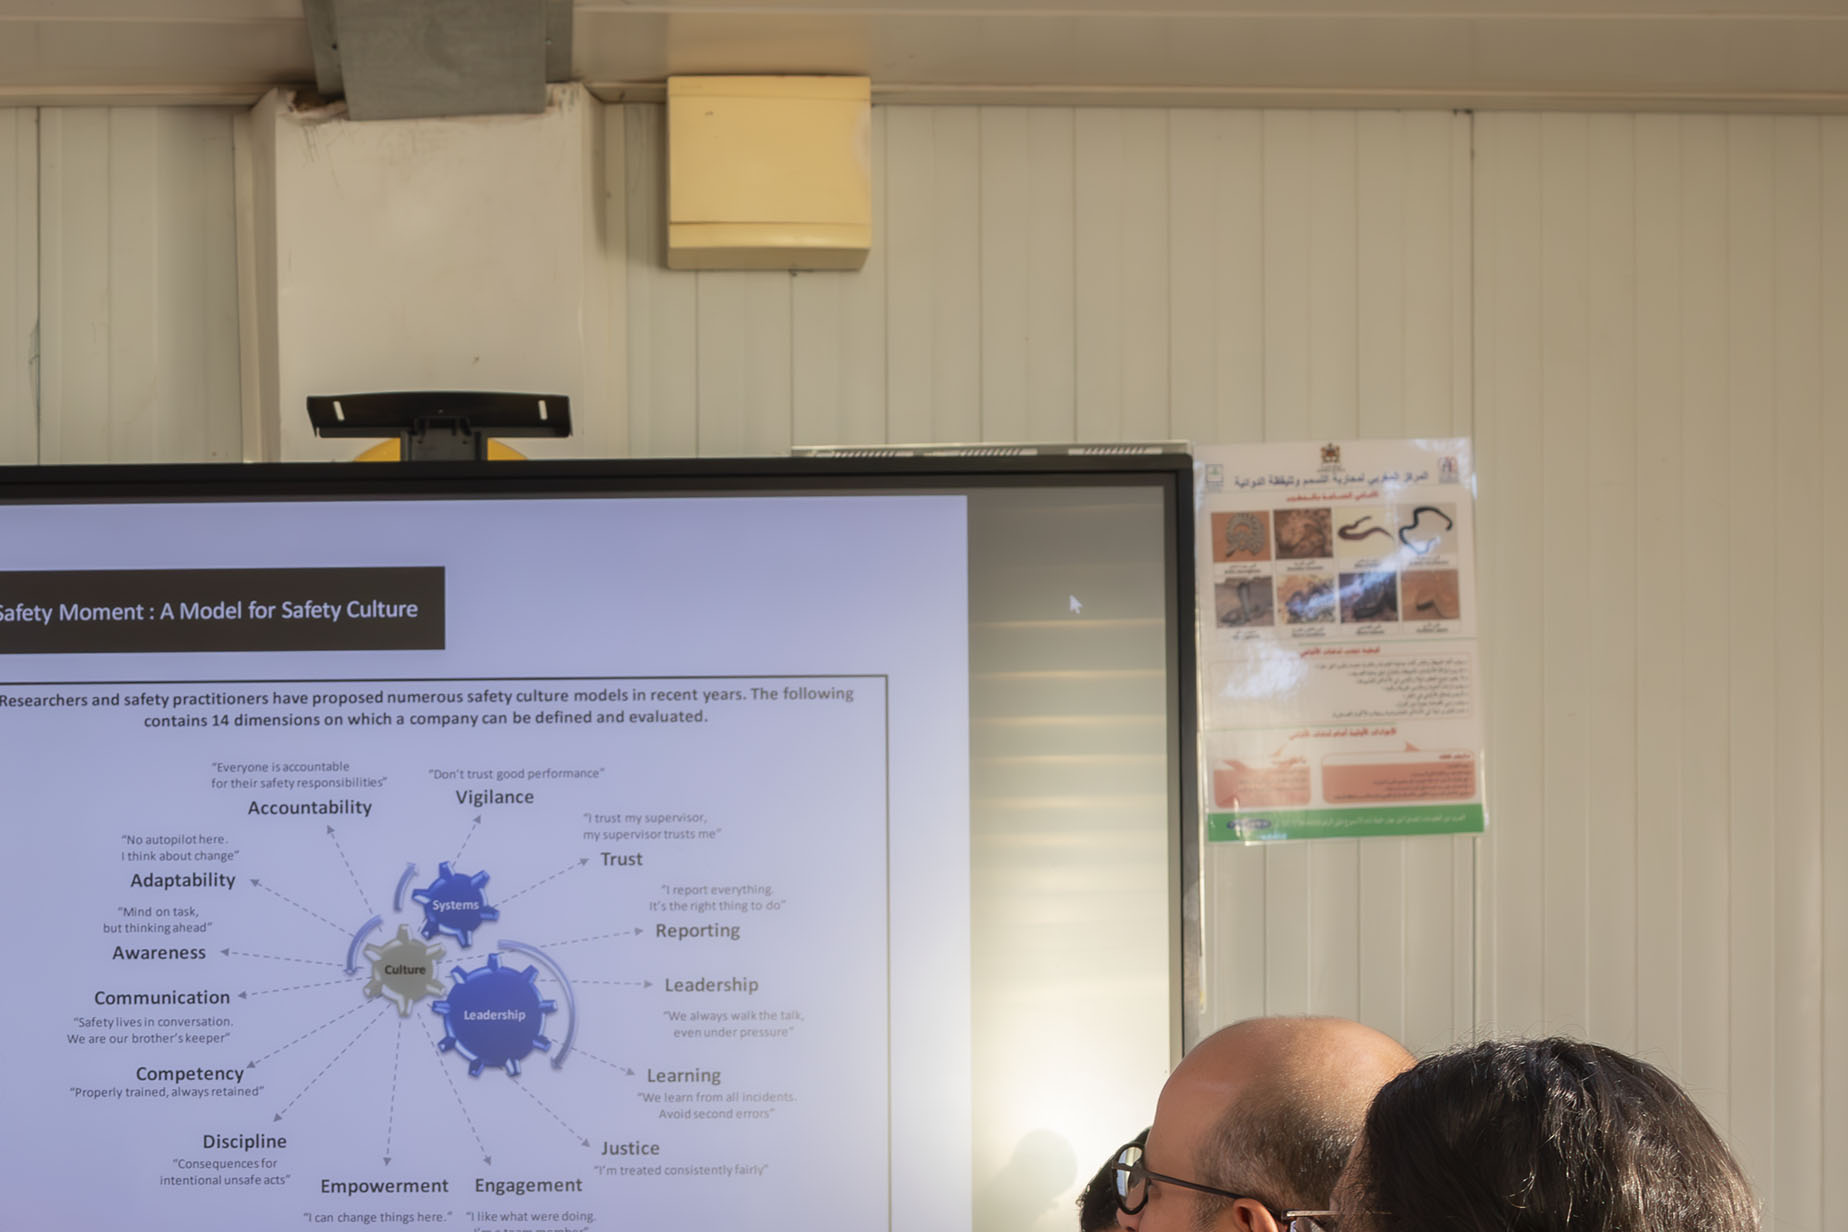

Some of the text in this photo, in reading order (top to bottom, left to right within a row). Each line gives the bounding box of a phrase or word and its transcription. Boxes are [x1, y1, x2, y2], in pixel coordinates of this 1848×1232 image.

[58, 604, 145, 620] Moment
[159, 603, 176, 619] A
[179, 601, 243, 619] Model
[248, 601, 276, 619] for
[280, 600, 342, 622] Safety
[346, 600, 419, 618] Culture
[91, 693, 120, 706] and
[123, 692, 169, 708] safety
[172, 692, 269, 708] practitioners
[272, 692, 309, 704] have
[312, 691, 384, 707] proposed
[386, 693, 463, 703] numerous
[466, 689, 513, 705] safety
[515, 689, 569, 702] culture
[573, 689, 629, 701] models
[632, 689, 647, 701] in
[650, 690, 698, 701] recent
[702, 691, 747, 704] years.
[750, 688, 779, 700] The
[782, 687, 855, 702] following
[143, 710, 709, 727] contains 14 dimensions on which a company can be defined and evaluated.
[271, 763, 281, 772] is
[282, 761, 350, 772] accountable
[467, 770, 494, 779] trust
[496, 769, 525, 781] good
[211, 778, 228, 788] for
[230, 779, 258, 788] their
[259, 778, 295, 790] safety
[455, 789, 535, 807] Vigilance
[247, 800, 373, 817] Accountability
[145, 835, 198, 846] autopilot
[198, 834, 230, 844] here.
[120, 852, 125, 861] I
[126, 851, 157, 861] think
[158, 851, 192, 861] about
[600, 852, 644, 866] Trust
[129, 872, 237, 890] Adaptability
[155, 909, 170, 917] on
[172, 907, 200, 918] task,
[431, 900, 481, 912] Systems
[102, 923, 123, 933] but
[124, 923, 172, 935] thinking
[655, 923, 741, 941] Reporting
[111, 946, 207, 959] Awareness
[383, 965, 427, 975] Culture
[664, 977, 760, 994] Leadership
[93, 990, 231, 1005] Communication
[115, 1017, 142, 1027] lives
[143, 1017, 155, 1026] in
[157, 1017, 235, 1027] conversation.
[462, 1010, 527, 1022] Leadership
[66, 1035, 84, 1044] We
[86, 1036, 107, 1044] are
[108, 1036, 129, 1044] our
[135, 1067, 245, 1084] Competency
[646, 1068, 722, 1085] Learning
[124, 1087, 170, 1098] trained,
[170, 1087, 210, 1098] always
[202, 1134, 288, 1152] Discipline
[600, 1141, 661, 1155] Justice
[260, 1158, 278, 1168] for
[159, 1175, 222, 1185] intentional
[223, 1175, 263, 1185] unsafe
[320, 1180, 450, 1196] Empowerment
[474, 1179, 584, 1195] Engagement
[336, 1213, 377, 1224] change
[379, 1212, 415, 1224] things
